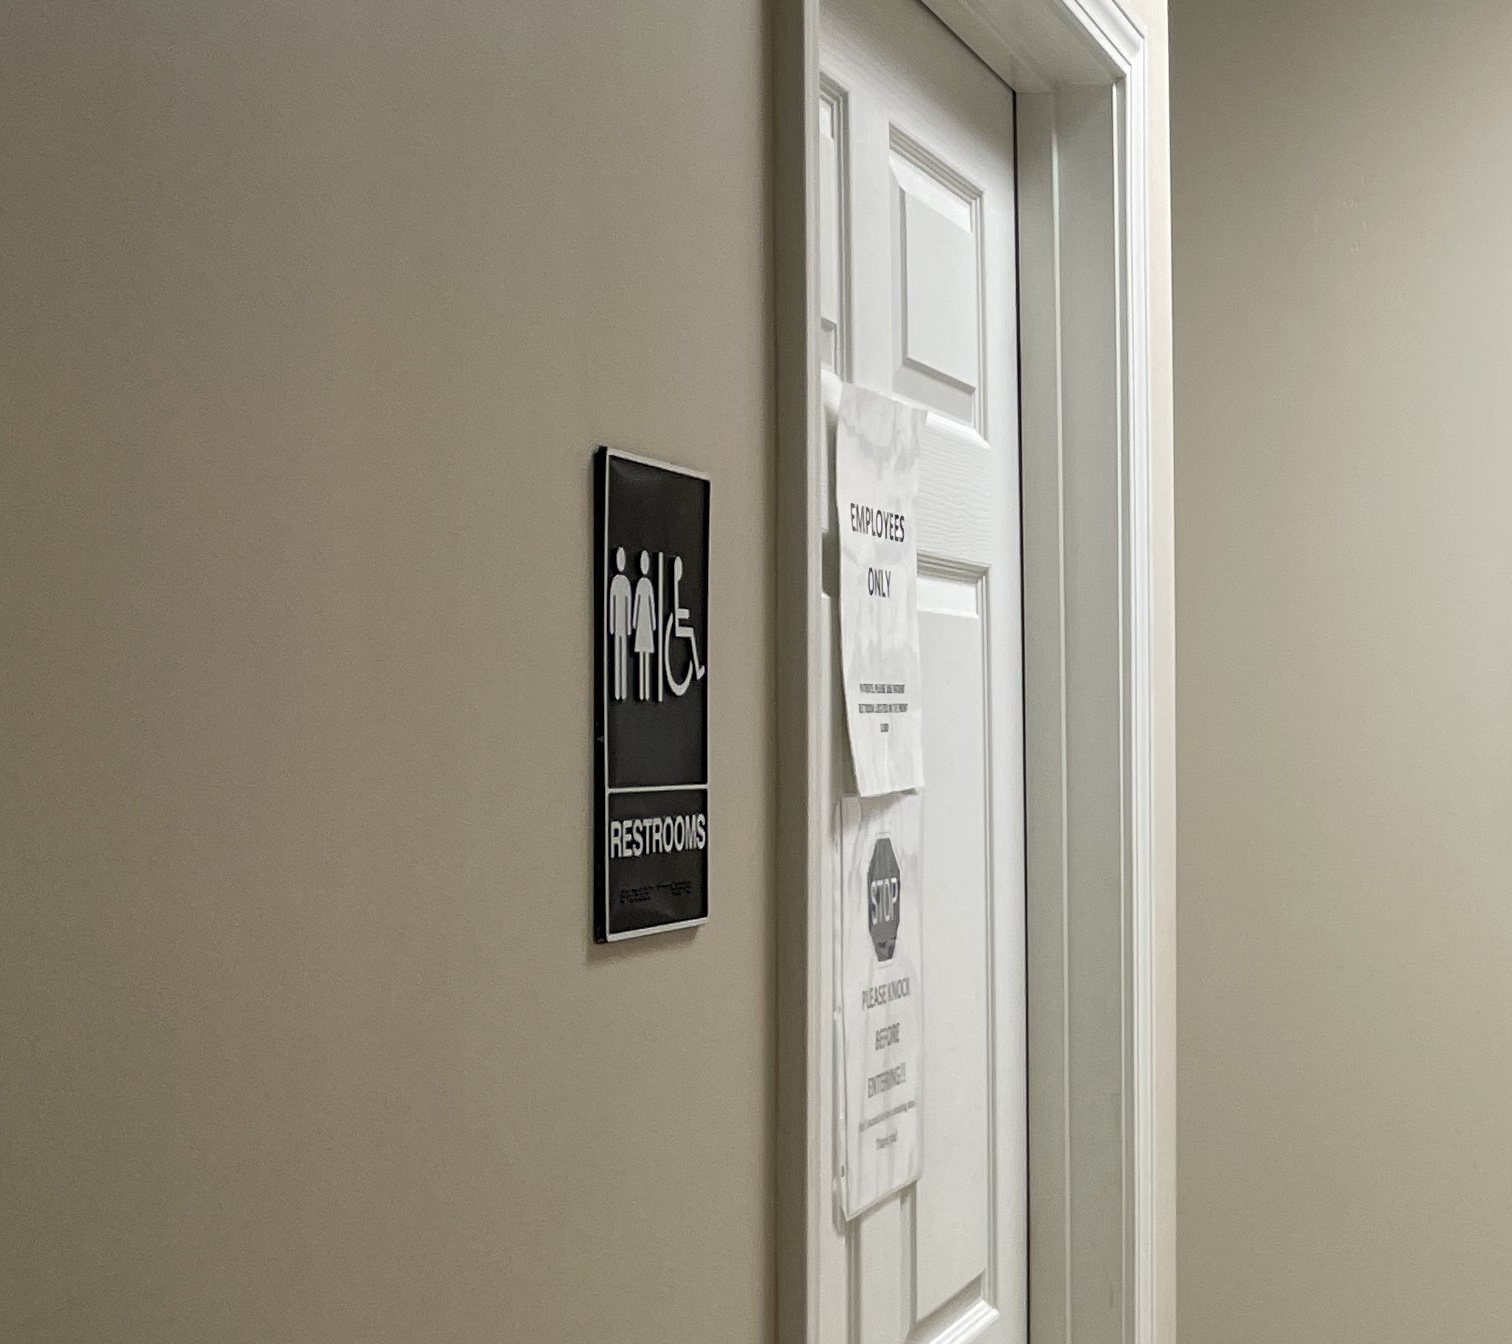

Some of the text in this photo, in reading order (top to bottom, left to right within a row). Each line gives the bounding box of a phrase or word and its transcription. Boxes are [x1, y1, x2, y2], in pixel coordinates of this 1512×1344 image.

[850, 502, 905, 543] EMPLOYEES
[867, 566, 891, 598] ONLY
[610, 813, 706, 859] RESTROOMS
[870, 877, 898, 925] STOP
